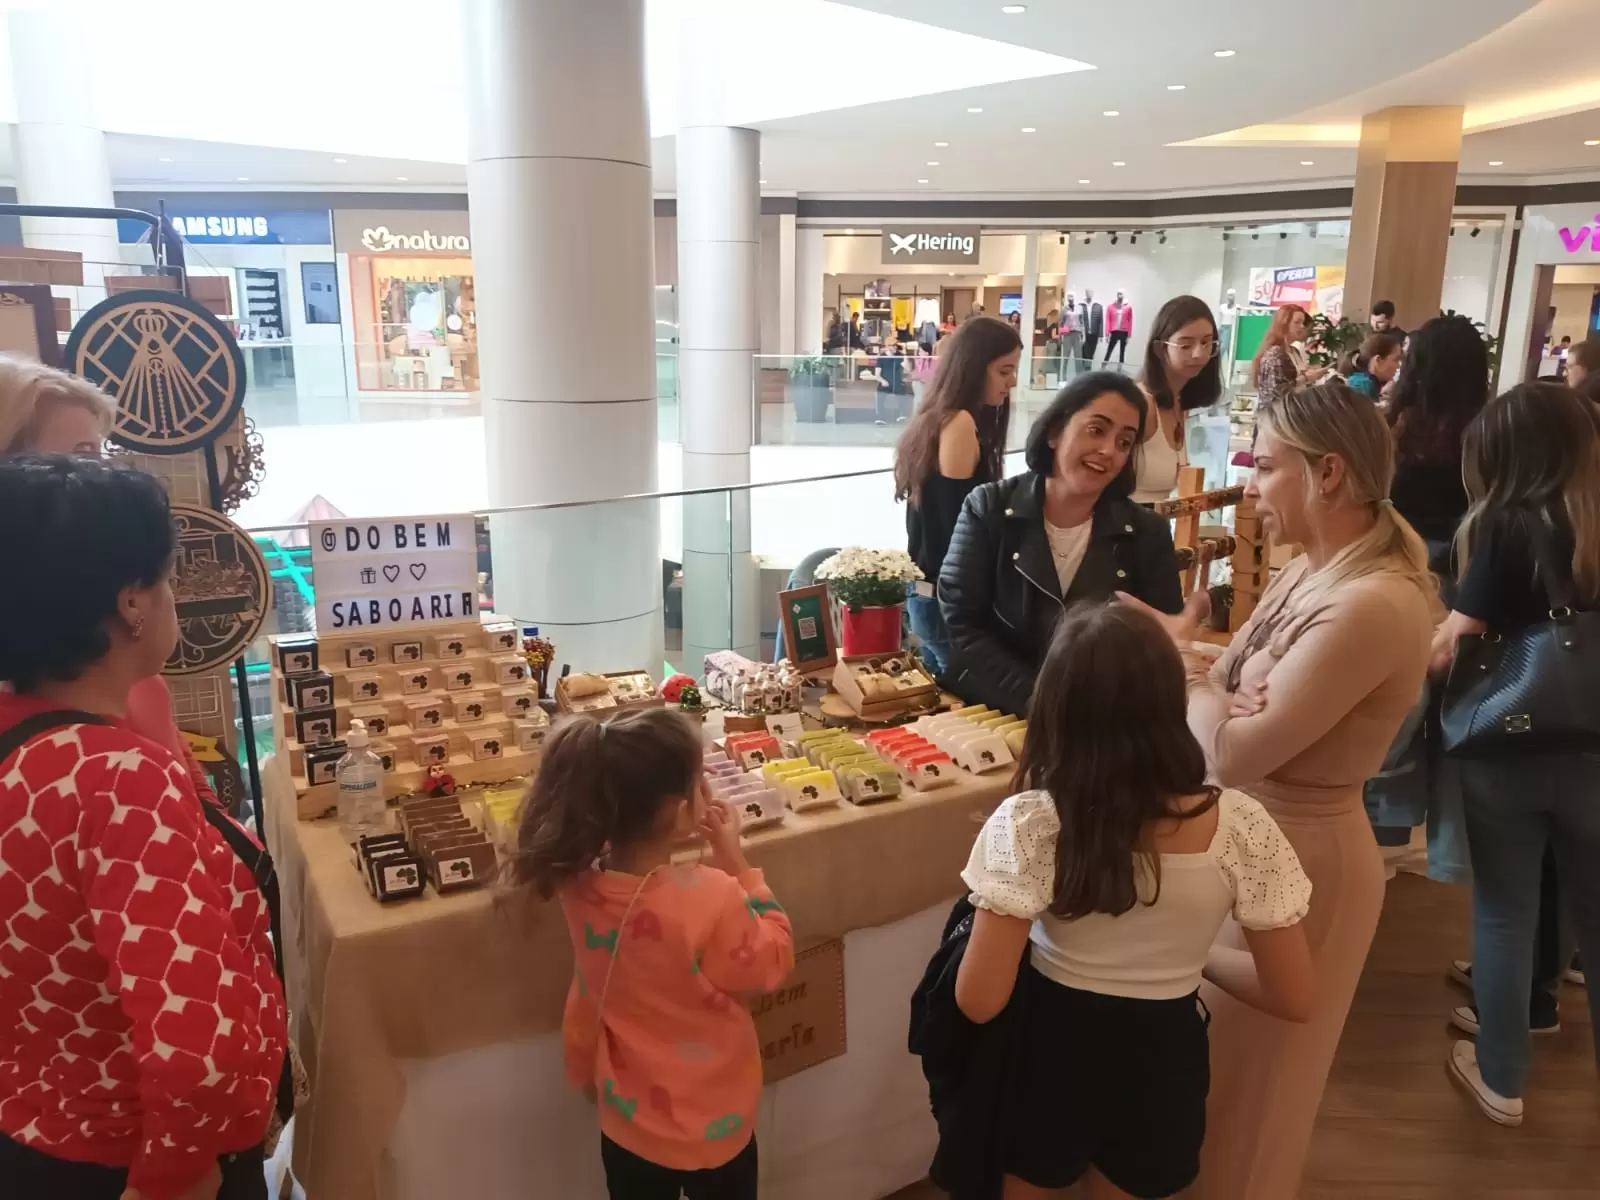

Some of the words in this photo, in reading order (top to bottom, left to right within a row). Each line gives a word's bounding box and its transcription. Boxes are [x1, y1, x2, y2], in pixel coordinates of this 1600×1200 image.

[172, 216, 268, 237] AMSUNG
[393, 229, 469, 251] natura
[917, 232, 975, 255] Hering
[394, 522, 450, 549] BEM
[332, 592, 473, 628] SABOARIA
